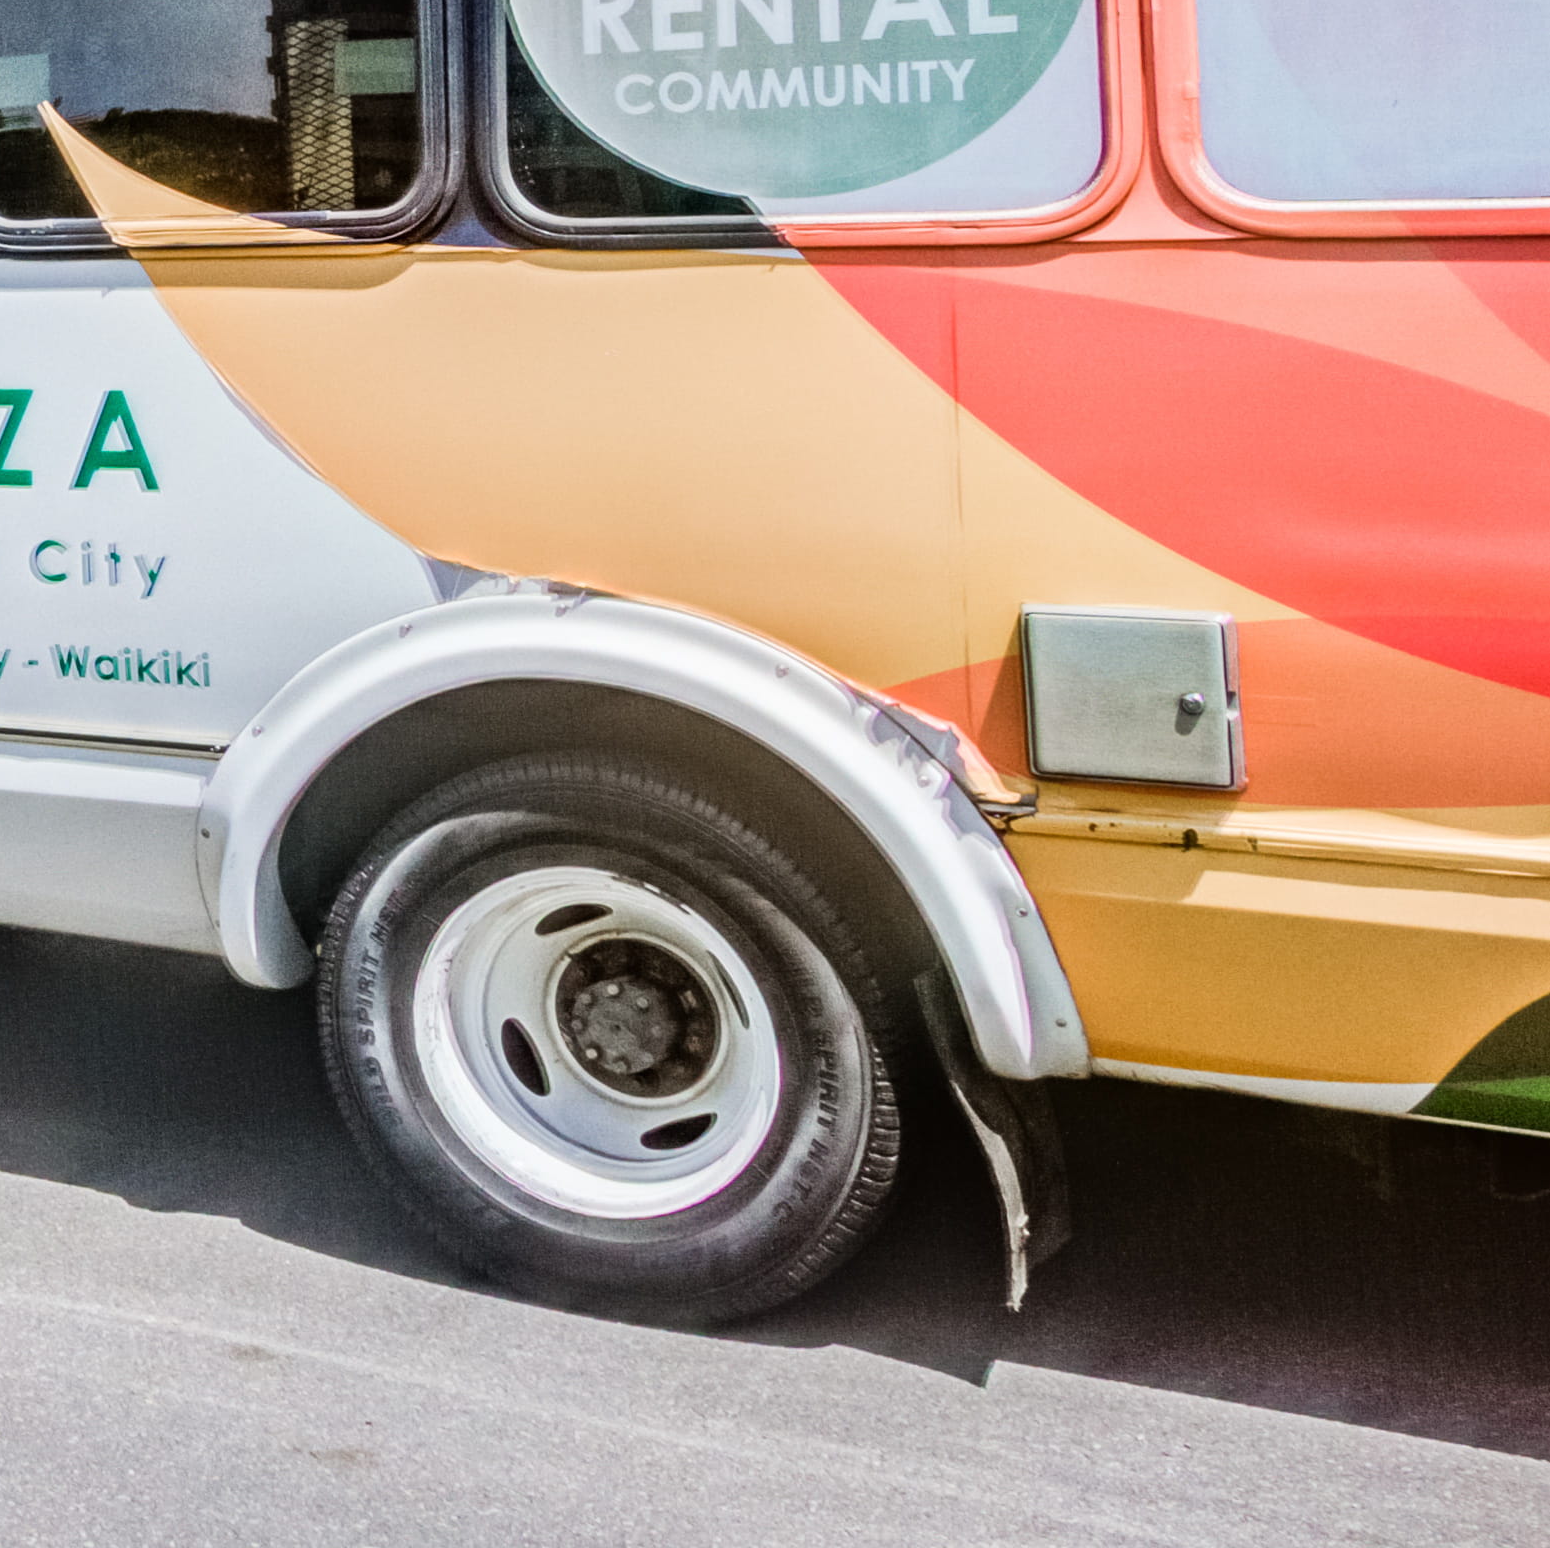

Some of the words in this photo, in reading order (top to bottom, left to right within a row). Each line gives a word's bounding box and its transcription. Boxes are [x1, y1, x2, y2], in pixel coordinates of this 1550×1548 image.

[615, 59, 975, 115] COMMUNITY
[29, 539, 166, 599] City
[51, 643, 211, 689] Waikiki
[355, 947, 380, 1048] SPIRIT
